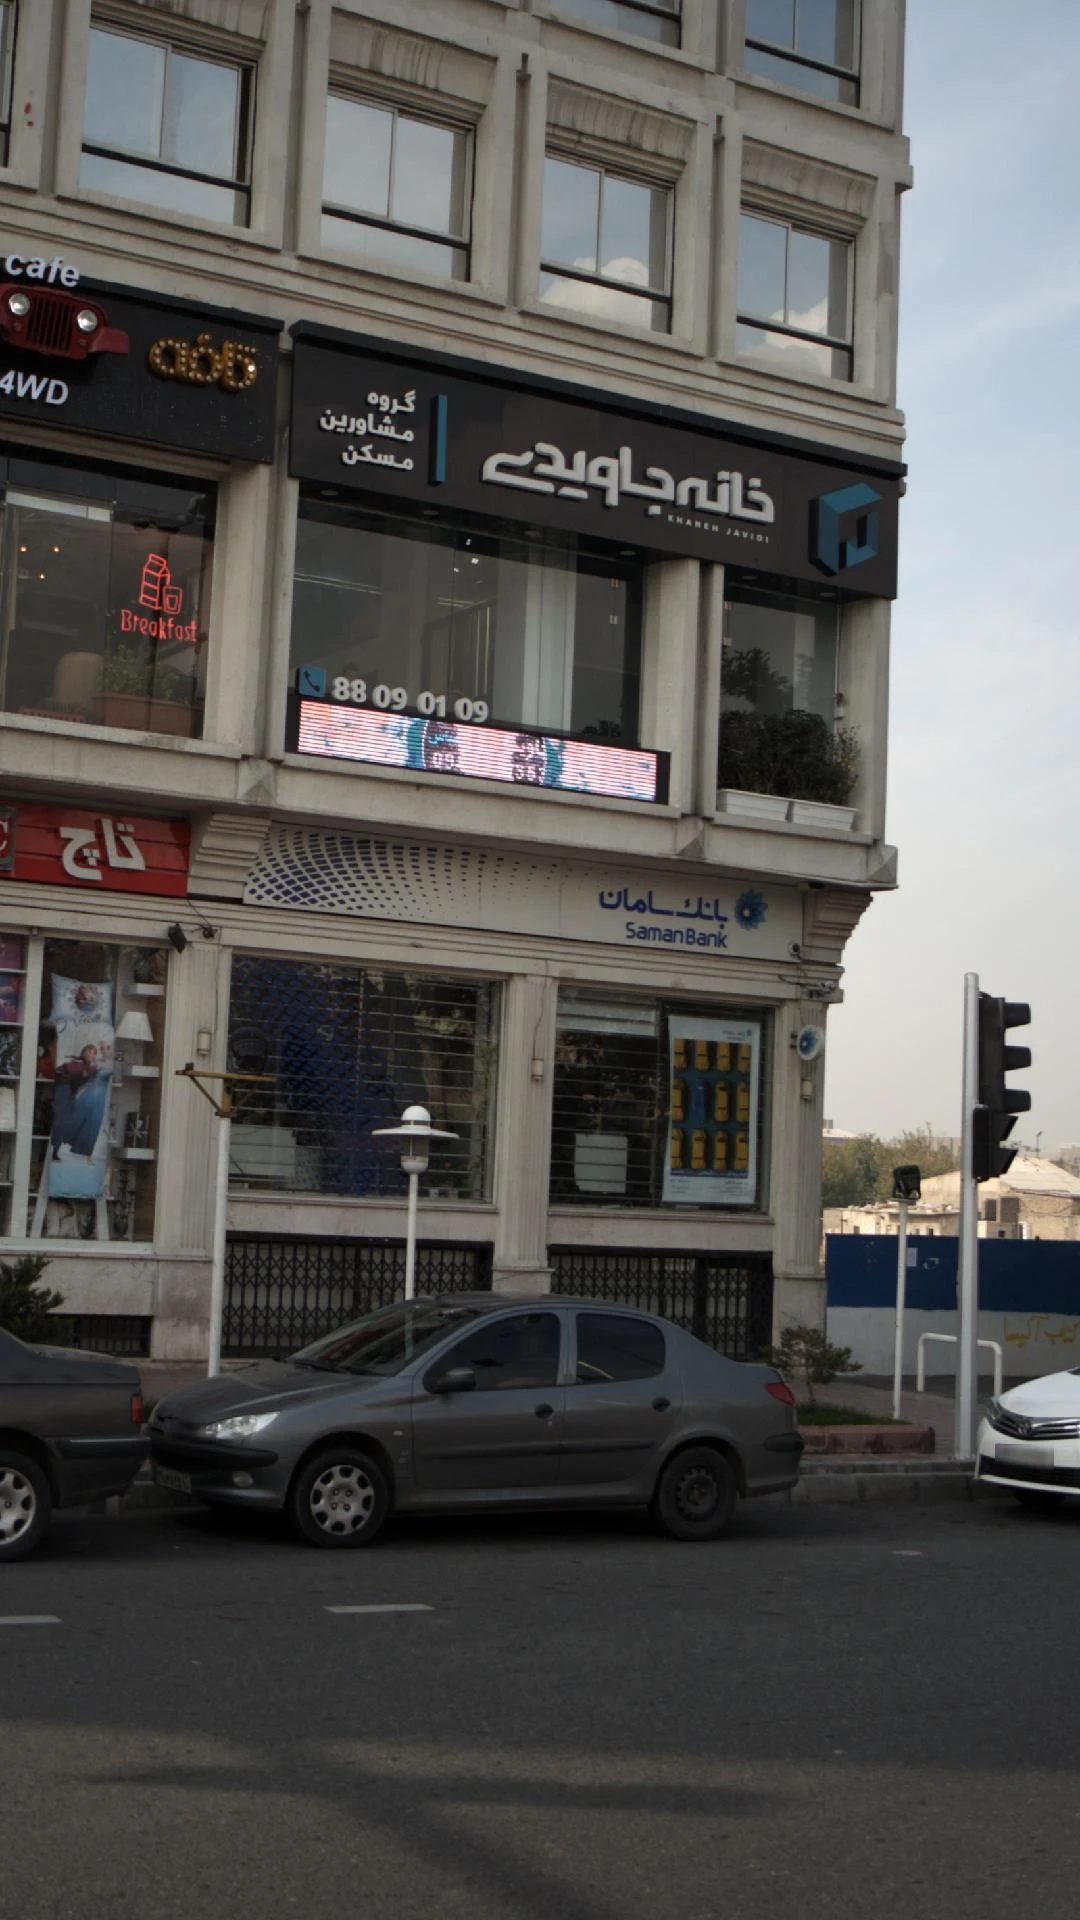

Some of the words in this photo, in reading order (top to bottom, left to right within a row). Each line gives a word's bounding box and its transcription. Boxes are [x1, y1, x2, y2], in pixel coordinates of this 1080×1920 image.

[5, 254, 80, 288] cafe
[0, 370, 69, 406] 4WD
[366, 389, 416, 413] گروه
[319, 409, 415, 443] مشاورین
[341, 444, 415, 472] مسکن
[667, 514, 720, 533] KHANEH
[726, 527, 770, 545] JAVIDI
[120, 608, 198, 643] Breakfast
[331, 676, 367, 702] 88
[372, 684, 408, 710] 09
[417, 691, 447, 718] 01
[454, 697, 489, 723] 09
[59, 817, 146, 882] تاچ
[598, 887, 675, 918] سامان
[675, 896, 729, 930] بانک
